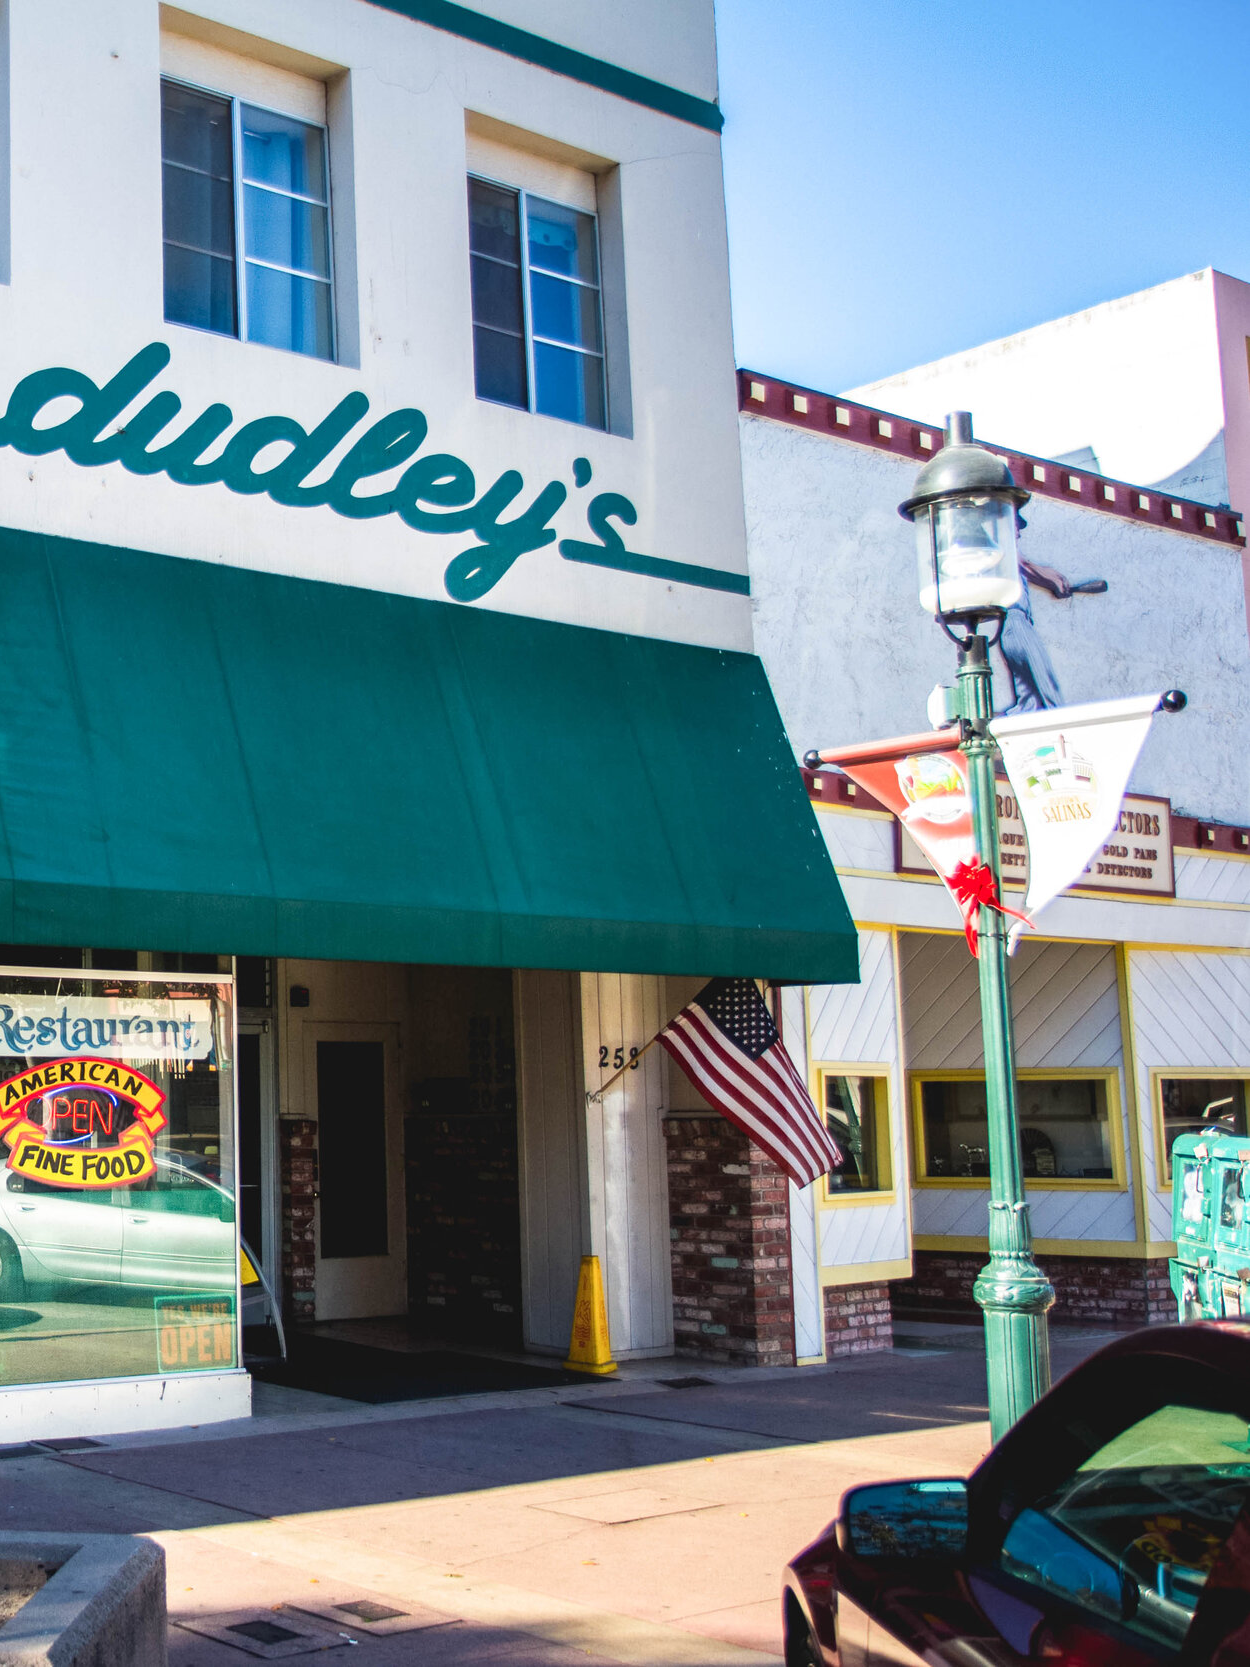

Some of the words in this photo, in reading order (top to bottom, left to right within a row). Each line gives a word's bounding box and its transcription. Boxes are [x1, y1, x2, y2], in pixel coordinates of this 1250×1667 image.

[6, 342, 637, 602] dudley's
[1042, 802, 1092, 823] SALINAS
[1096, 862, 1153, 879] DETECTORS
[1102, 844, 1128, 858] GOLD
[1133, 847, 1157, 861] PANS
[5, 1062, 144, 1105] AMERICAN
[25, 1096, 113, 1135] OPEN
[18, 1145, 74, 1175] FINE
[82, 1149, 145, 1180] FOOD
[161, 1323, 231, 1365] OPEN
